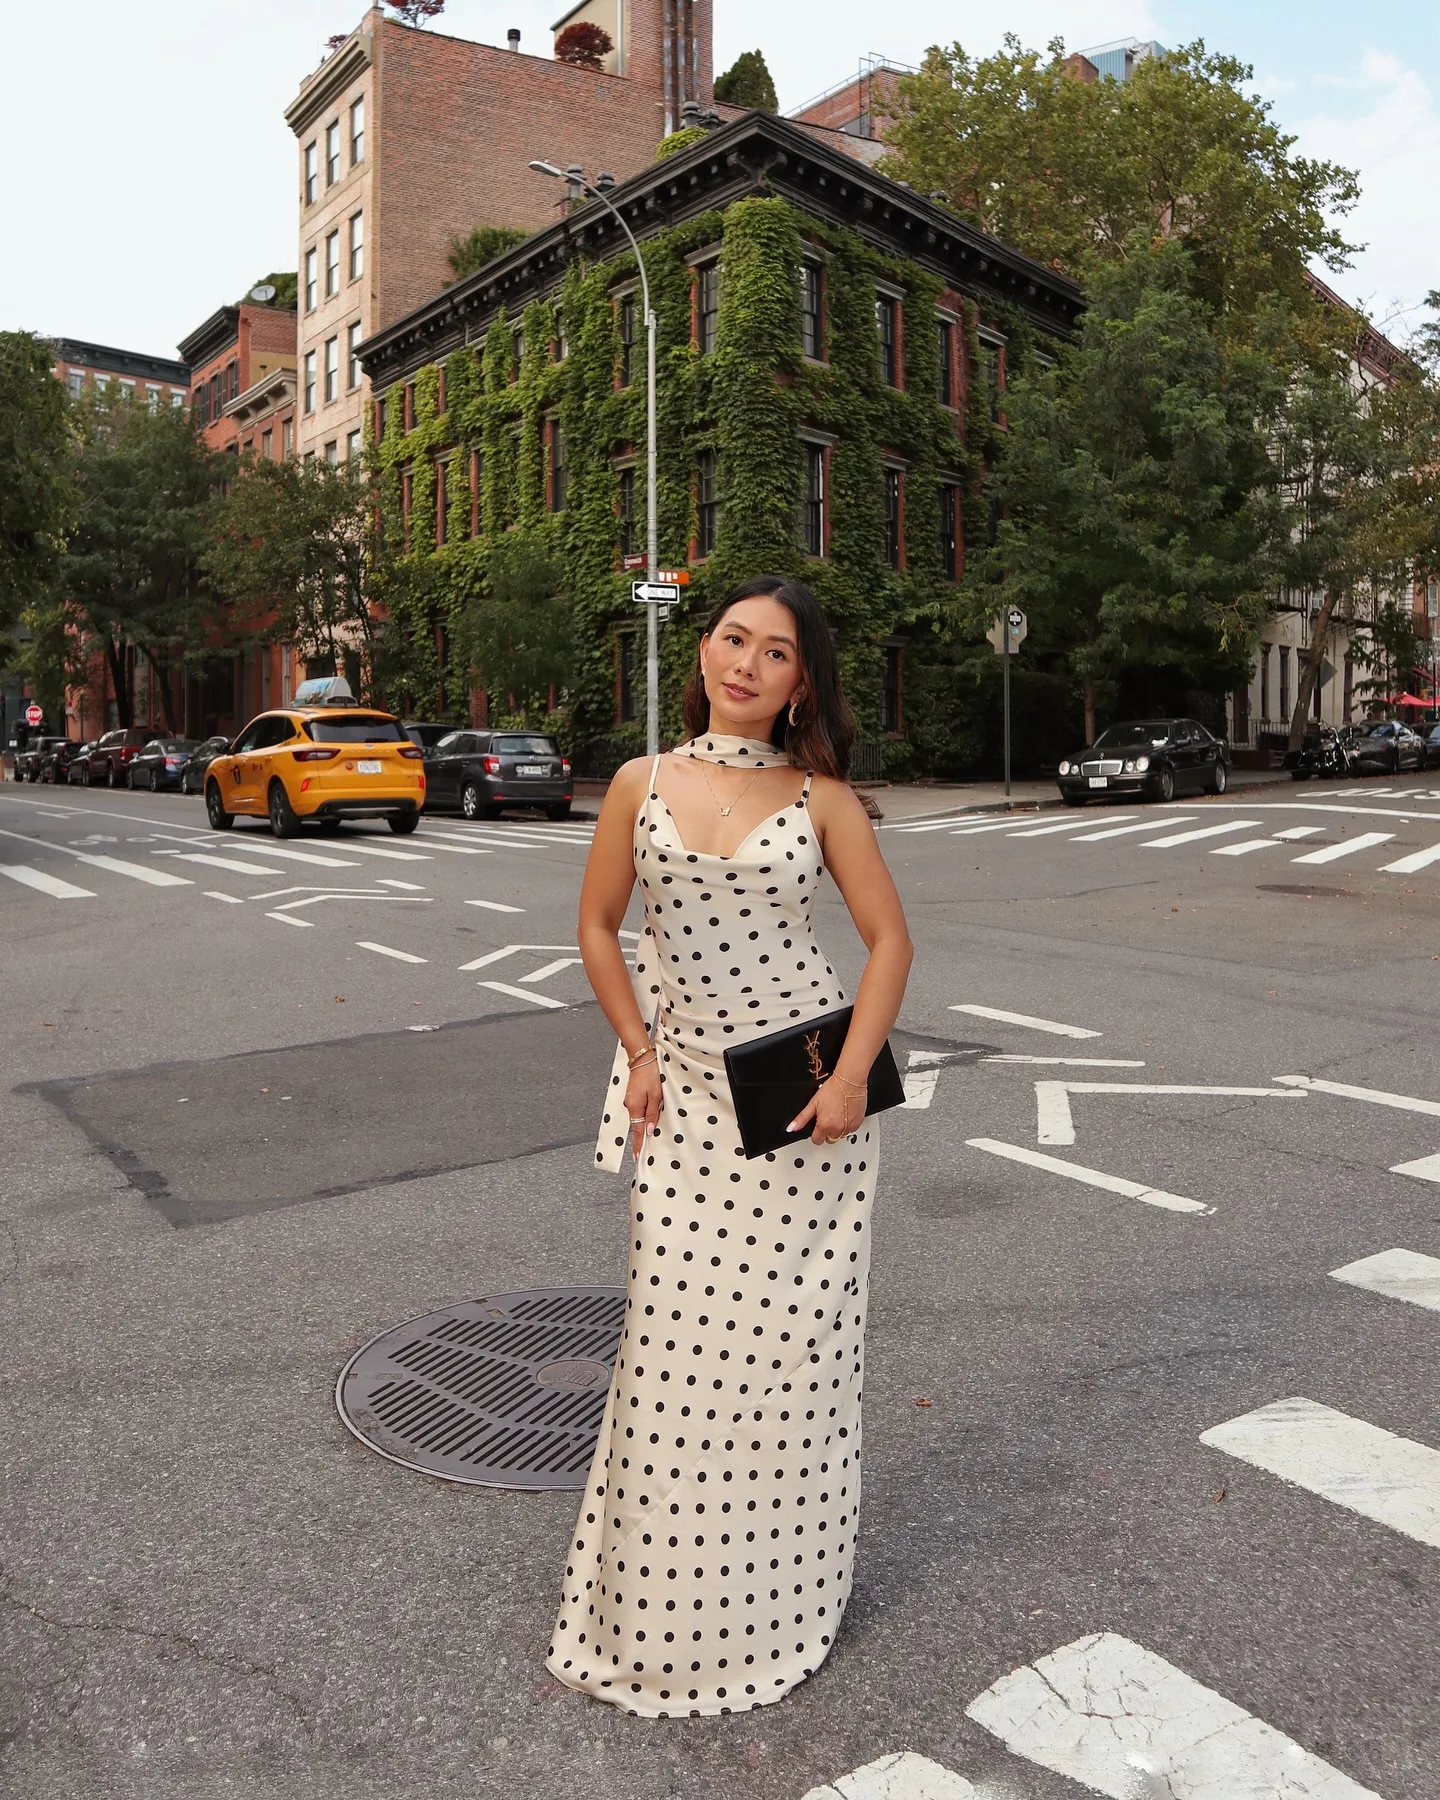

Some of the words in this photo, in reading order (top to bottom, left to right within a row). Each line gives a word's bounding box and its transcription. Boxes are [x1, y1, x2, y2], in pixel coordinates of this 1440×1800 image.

[647, 588, 659, 597] ONE
[27, 710, 42, 719] STOP
[803, 1030, 829, 1081] YSL
